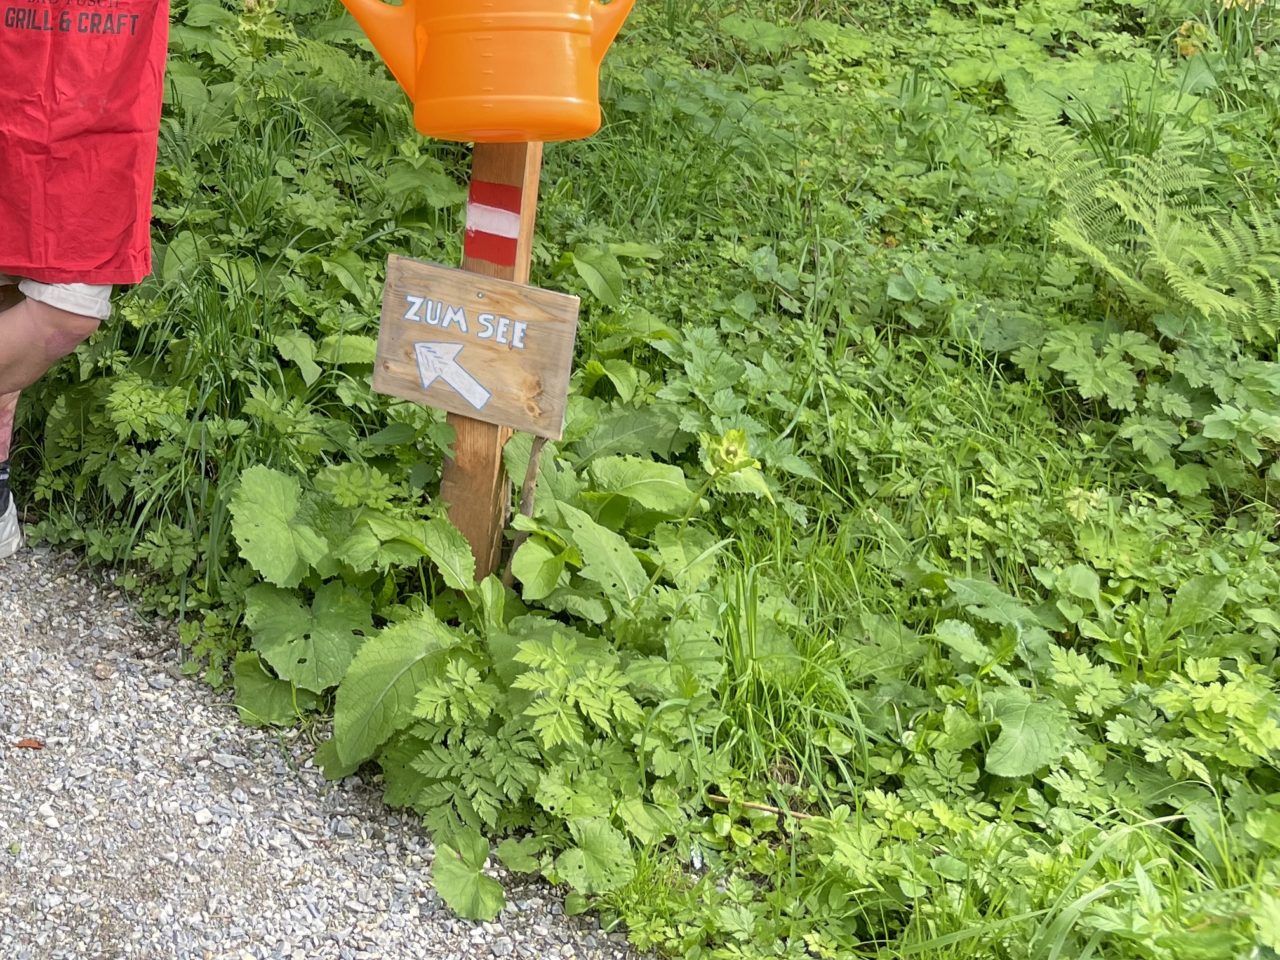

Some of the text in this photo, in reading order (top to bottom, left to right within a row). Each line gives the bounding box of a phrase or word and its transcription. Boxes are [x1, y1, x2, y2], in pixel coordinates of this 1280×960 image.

[5, 6, 139, 36] GRILL & CRAFT
[403, 295, 528, 349] ZUM SEE
